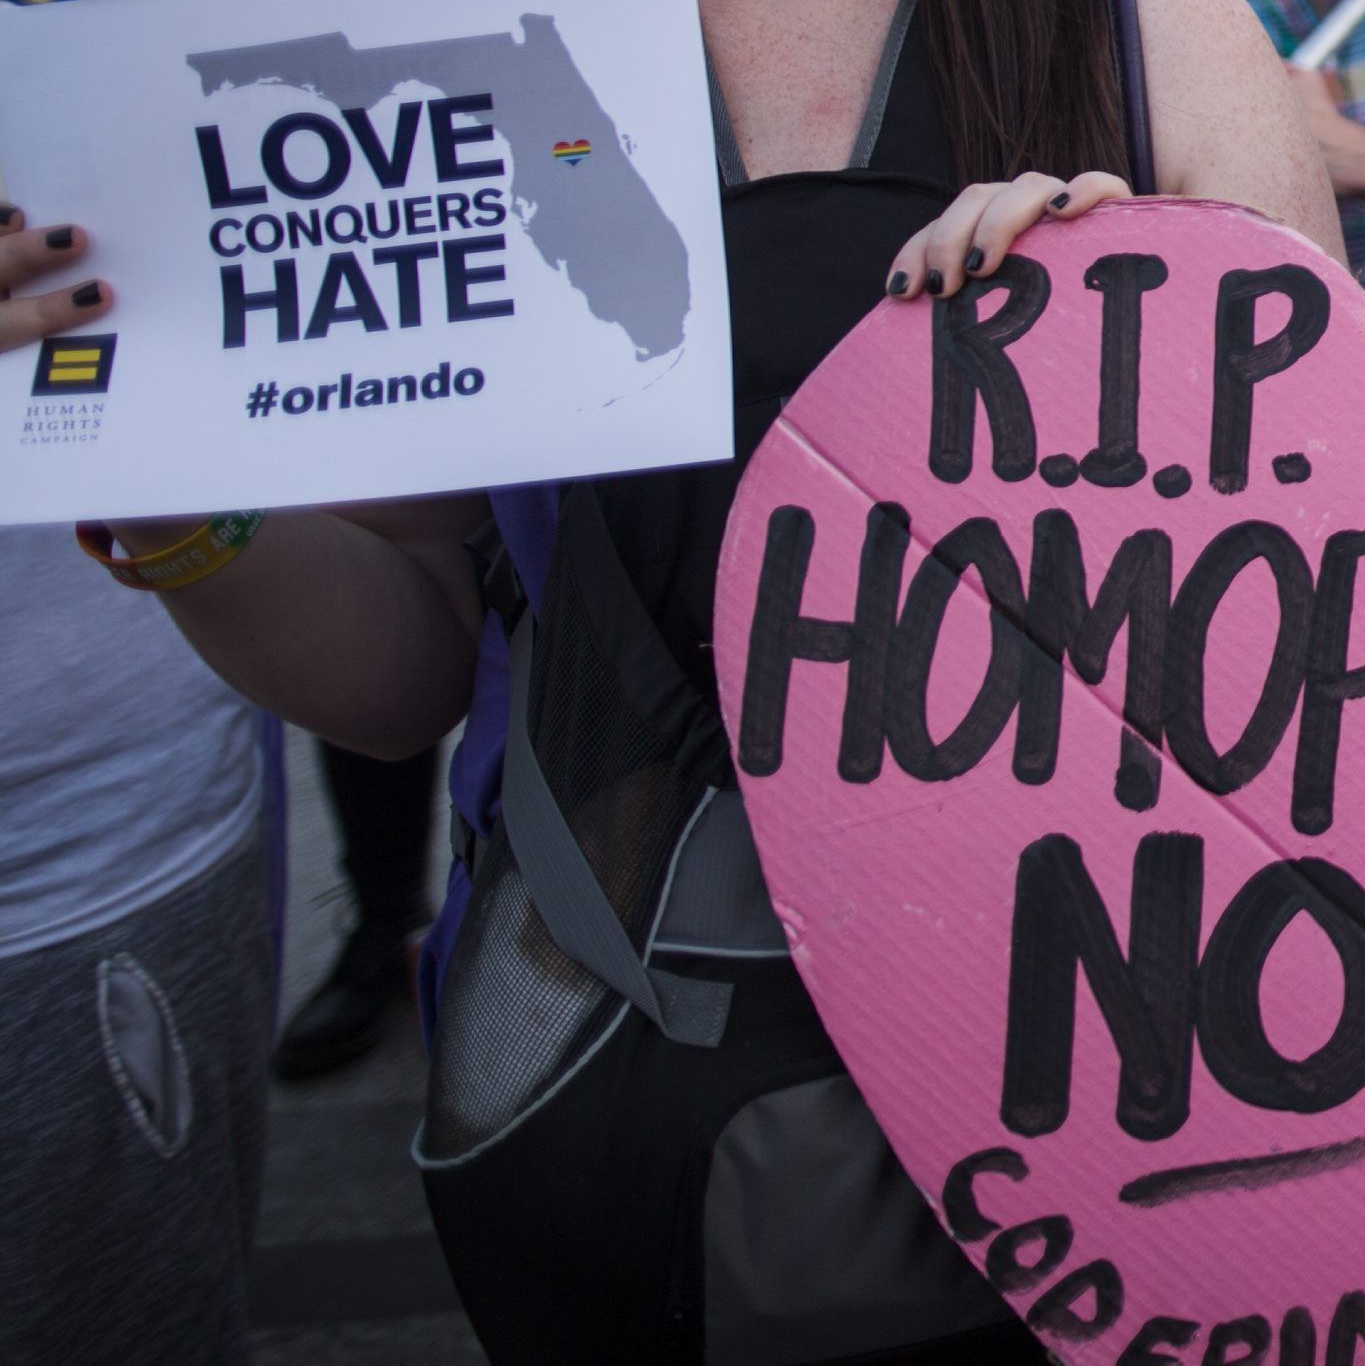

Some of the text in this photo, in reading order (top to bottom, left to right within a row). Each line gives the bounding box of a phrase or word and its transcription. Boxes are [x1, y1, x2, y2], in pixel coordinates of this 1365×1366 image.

[195, 93, 505, 209] LOVE
[209, 188, 507, 257] CONQUERS
[220, 233, 515, 349] HATE
[246, 362, 485, 418] #orlando
[929, 253, 1331, 499] R.I.P.
[20, 434, 98, 444] CAMPAIGN
[23, 419, 102, 432] RIGHTS
[27, 404, 104, 416] HUMAN
[139, 547, 208, 580] RIGHTS
[210, 518, 241, 552] ARE
